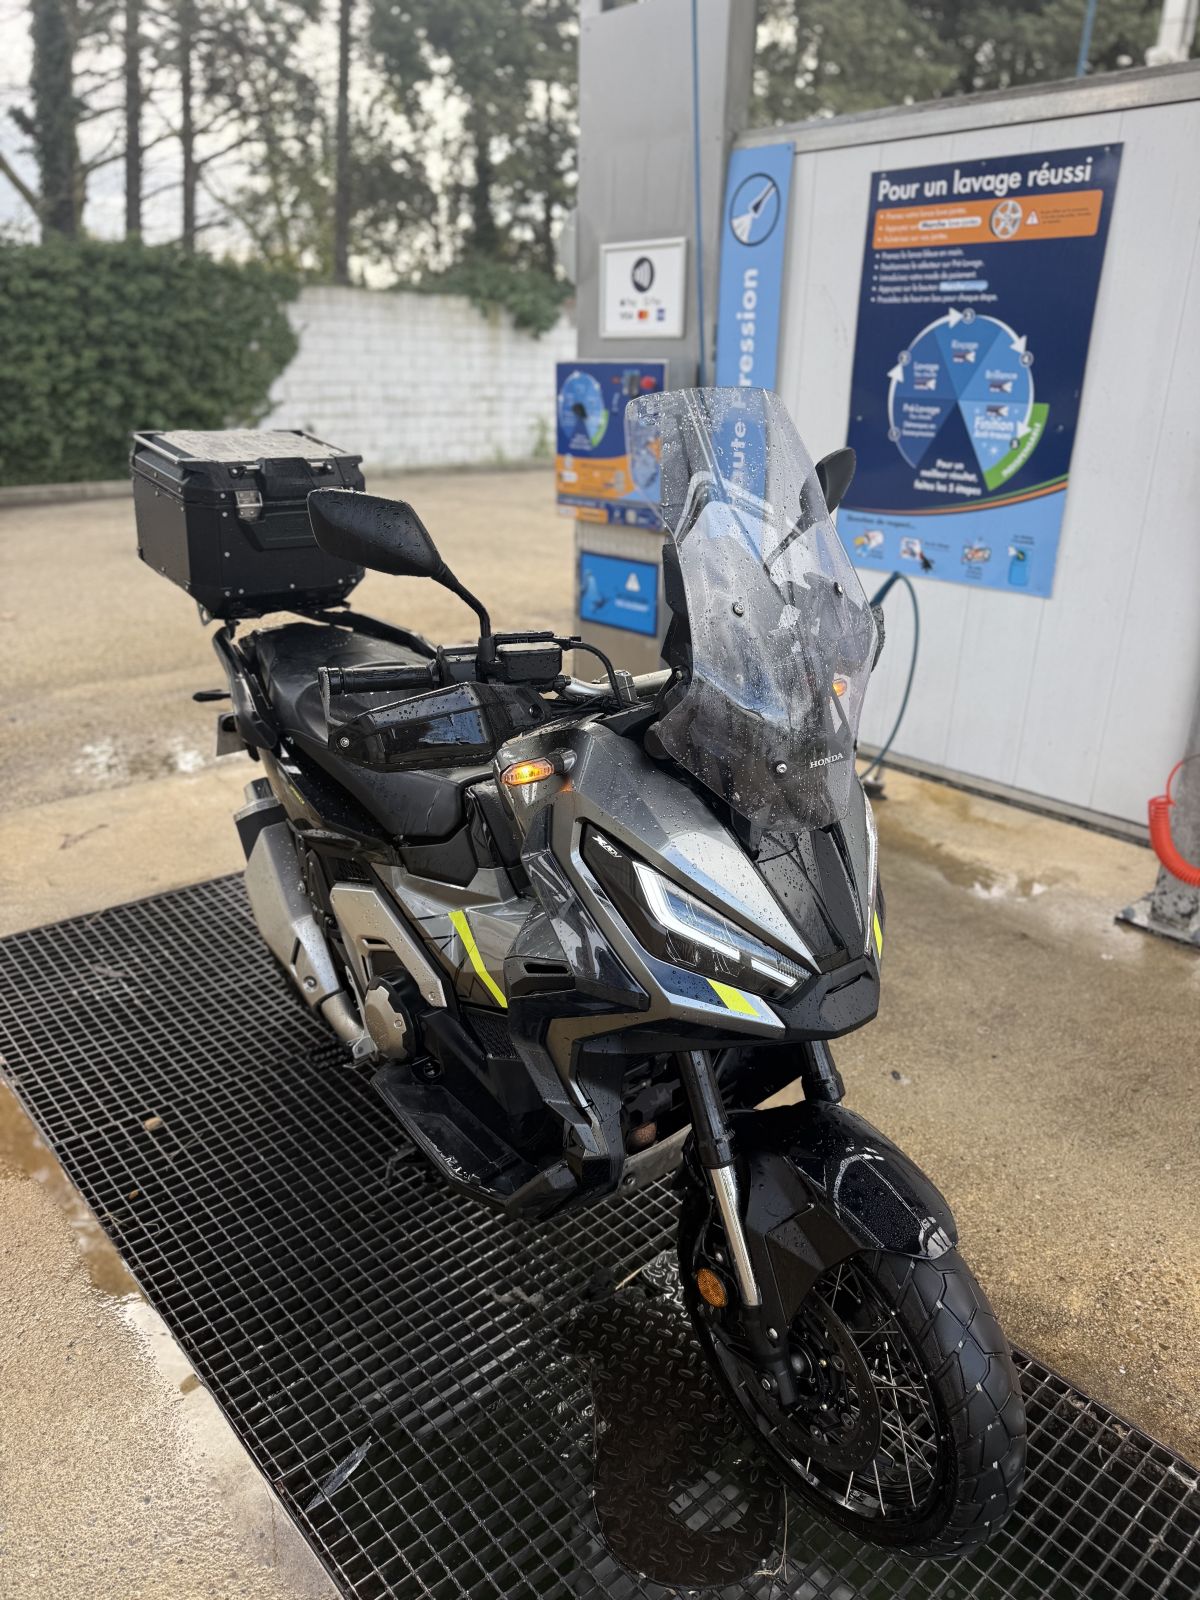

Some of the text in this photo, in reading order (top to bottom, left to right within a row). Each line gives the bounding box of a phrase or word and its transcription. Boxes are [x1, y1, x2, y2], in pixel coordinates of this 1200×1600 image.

[878, 156, 1093, 201] Pour un lavage réussi
[809, 752, 844, 769] HONDA
